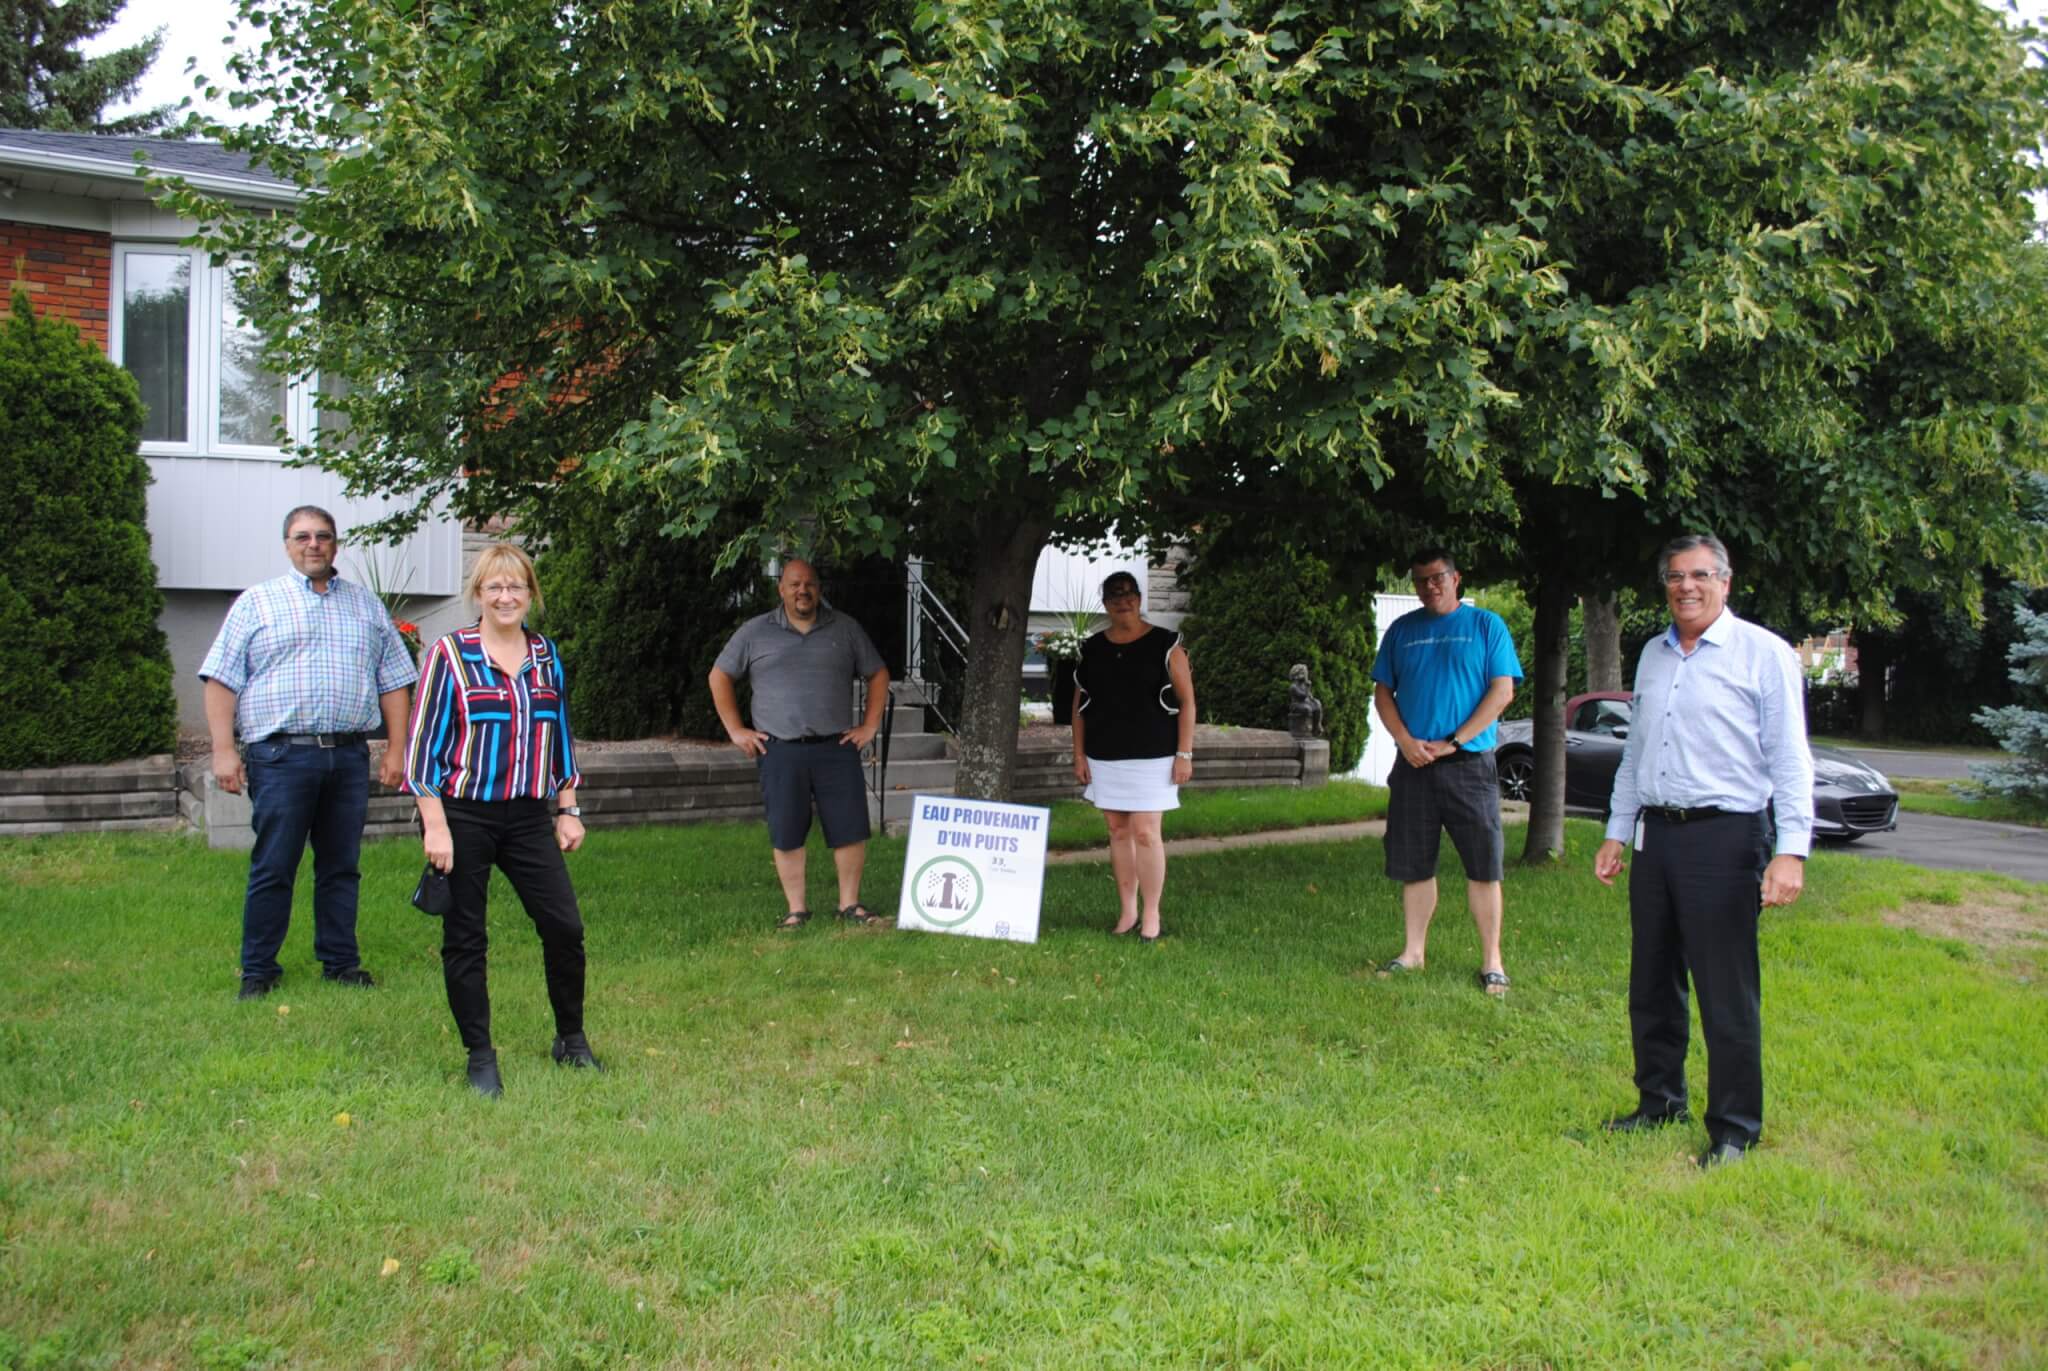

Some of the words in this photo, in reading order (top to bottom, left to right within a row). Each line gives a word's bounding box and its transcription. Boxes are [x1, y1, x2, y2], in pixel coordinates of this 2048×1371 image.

[922, 805, 950, 822] EAU
[953, 807, 1040, 831] PROVENANT
[937, 830, 971, 848] D'UN
[975, 834, 1019, 853] PUITS
